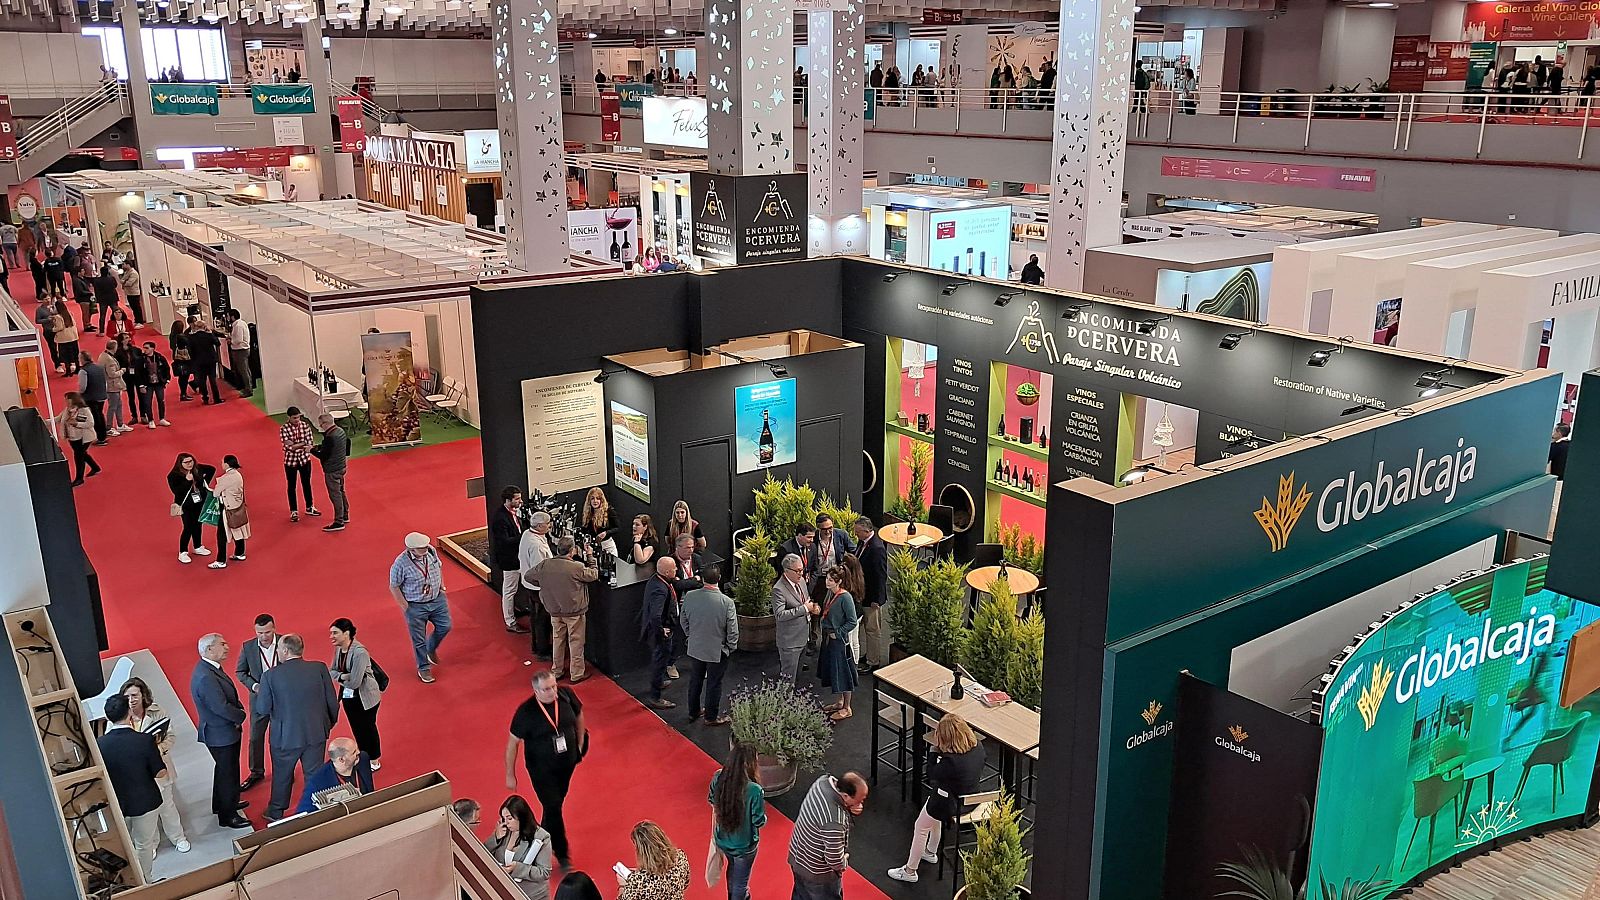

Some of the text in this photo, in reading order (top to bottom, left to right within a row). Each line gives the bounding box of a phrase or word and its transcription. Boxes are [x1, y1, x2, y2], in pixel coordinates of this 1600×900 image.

[1533, 4, 1549, 13] del
[1552, 3, 1576, 12] Vino
[1531, 12, 1594, 23] Wine Gallery
[169, 94, 215, 106] Globalcaja
[269, 94, 311, 104] Globalcaja
[612, 112, 619, 122] B
[1, 121, 11, 133] B
[354, 119, 362, 129] B
[612, 131, 619, 141] 7
[356, 140, 363, 150] 6
[5, 147, 14, 158] 5
[1233, 167, 1240, 175] C
[1340, 174, 1371, 182] FENAVIN
[695, 221, 731, 235] ENCOMIENDA
[745, 224, 800, 235] ENCOMIENDA
[751, 233, 800, 246] CERVERA
[1102, 284, 1135, 298] La Cendra
[1078, 327, 1181, 367] CERVERA
[954, 358, 972, 369] VINOS
[953, 365, 973, 377] TINTOS
[1062, 352, 1182, 390] Paraje Singular Volcánico
[945, 378, 980, 393] PETIT VERDOT
[1074, 387, 1097, 399] VINOS
[1273, 376, 1386, 409] Restoration of Native Varieties
[948, 394, 975, 407] GRACIANO
[1066, 393, 1105, 410] ESPECIALES
[948, 408, 974, 421] CABERNET
[1070, 411, 1098, 425] CRIANZA
[945, 414, 976, 429] SAUVIGNON
[1068, 418, 1099, 434] EN GRUTA
[944, 428, 977, 444] TEMPRANILLO
[1065, 425, 1101, 443] VOLCÁNICA
[1226, 424, 1253, 437] VINOS
[952, 445, 968, 456] SYRAH
[1062, 440, 1103, 459] MACERACIÓN
[947, 458, 971, 472] CENCIBEL
[1316, 438, 1477, 532] Globalcaja
[1395, 606, 1556, 704] Globalcaja
[1125, 719, 1174, 750] Globalcaja
[1214, 734, 1261, 764] Globalcaja
